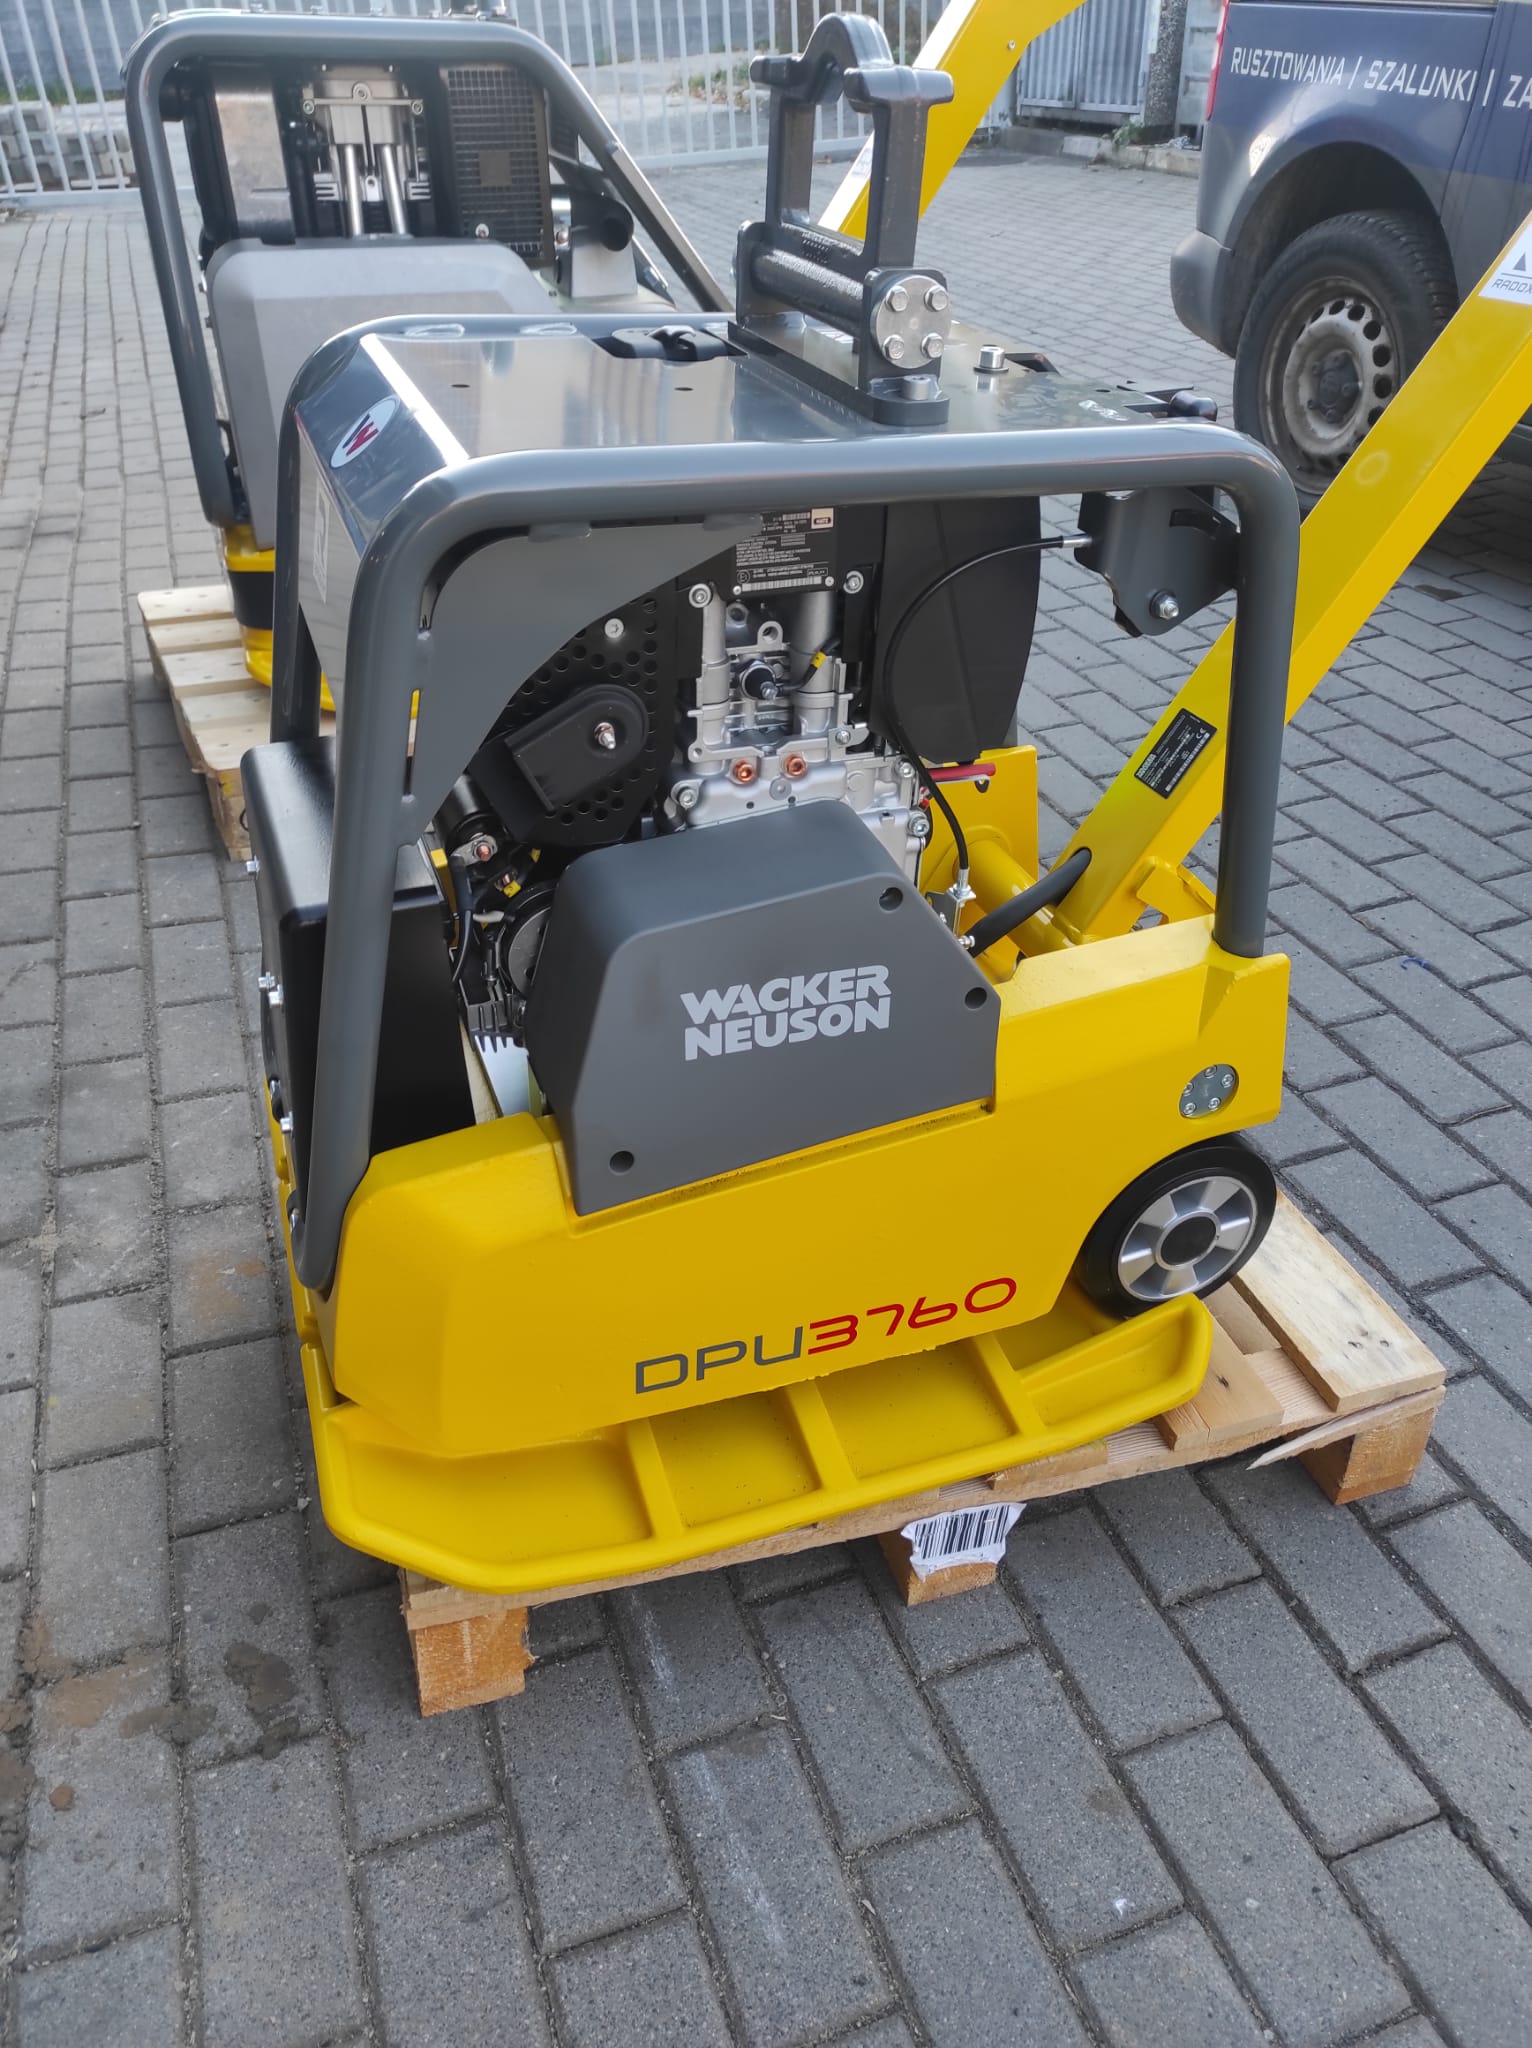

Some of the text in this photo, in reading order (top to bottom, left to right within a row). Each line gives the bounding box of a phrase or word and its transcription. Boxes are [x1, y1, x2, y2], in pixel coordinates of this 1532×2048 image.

[1231, 47, 1346, 85] RUSZTOWANIA
[1364, 60, 1478, 102] SZALUNKI
[680, 965, 892, 1025] WACKER
[684, 997, 891, 1061] NEUSON
[636, 1277, 1017, 1394] DPU3760
